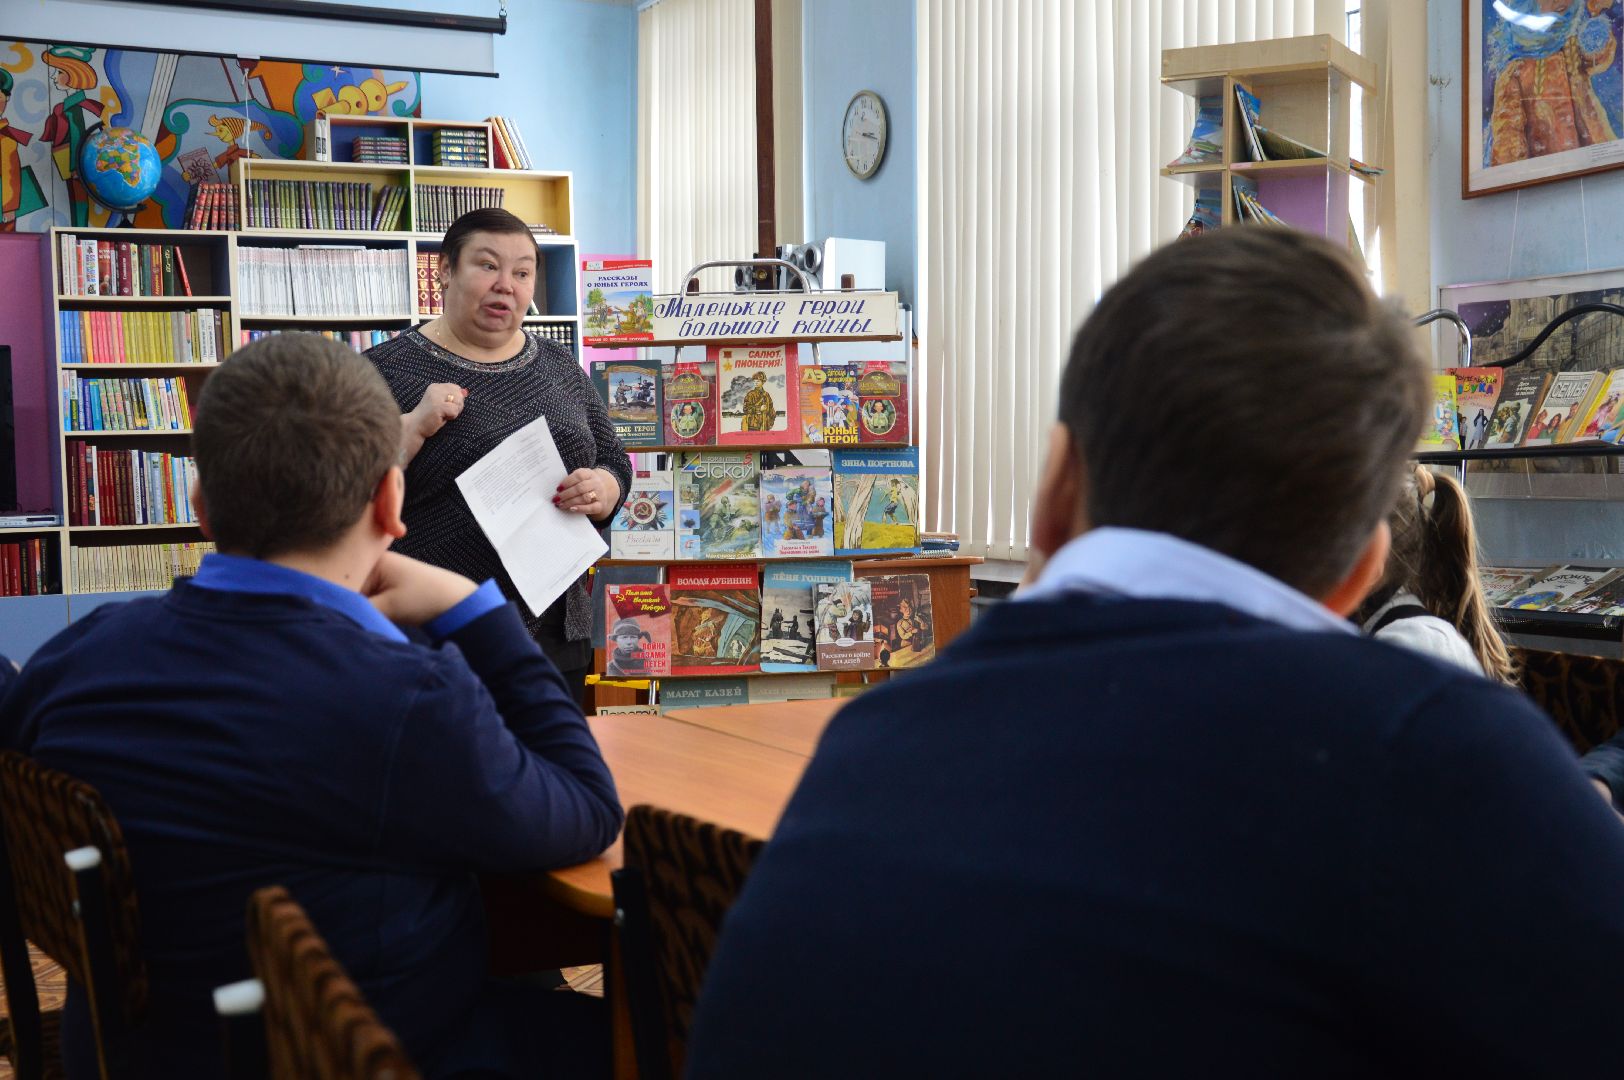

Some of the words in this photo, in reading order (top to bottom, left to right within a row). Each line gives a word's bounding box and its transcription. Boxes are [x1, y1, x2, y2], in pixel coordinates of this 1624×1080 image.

[654, 297, 786, 319] Маленькие
[798, 299, 866, 319] герои
[678, 315, 780, 338] большой
[791, 315, 874, 335] войны
[734, 358, 784, 369] ПИОНЕРИЯ!
[823, 427, 859, 435] ЮНЫЕ
[823, 435, 859, 444] ГЕРОИ
[842, 459, 865, 467] ЗИНА
[867, 460, 915, 468] ПОРТНОВА
[677, 577, 709, 585] ВОЛОДЯ
[710, 577, 752, 586] ДУБИНИН
[772, 572, 799, 582] ЛЁНЯ
[801, 573, 847, 583] ГОЛИКОВ
[642, 641, 666, 650] ВОЙНА
[665, 689, 702, 699] МАРАТ
[704, 687, 742, 698] КАЗЕЙ
